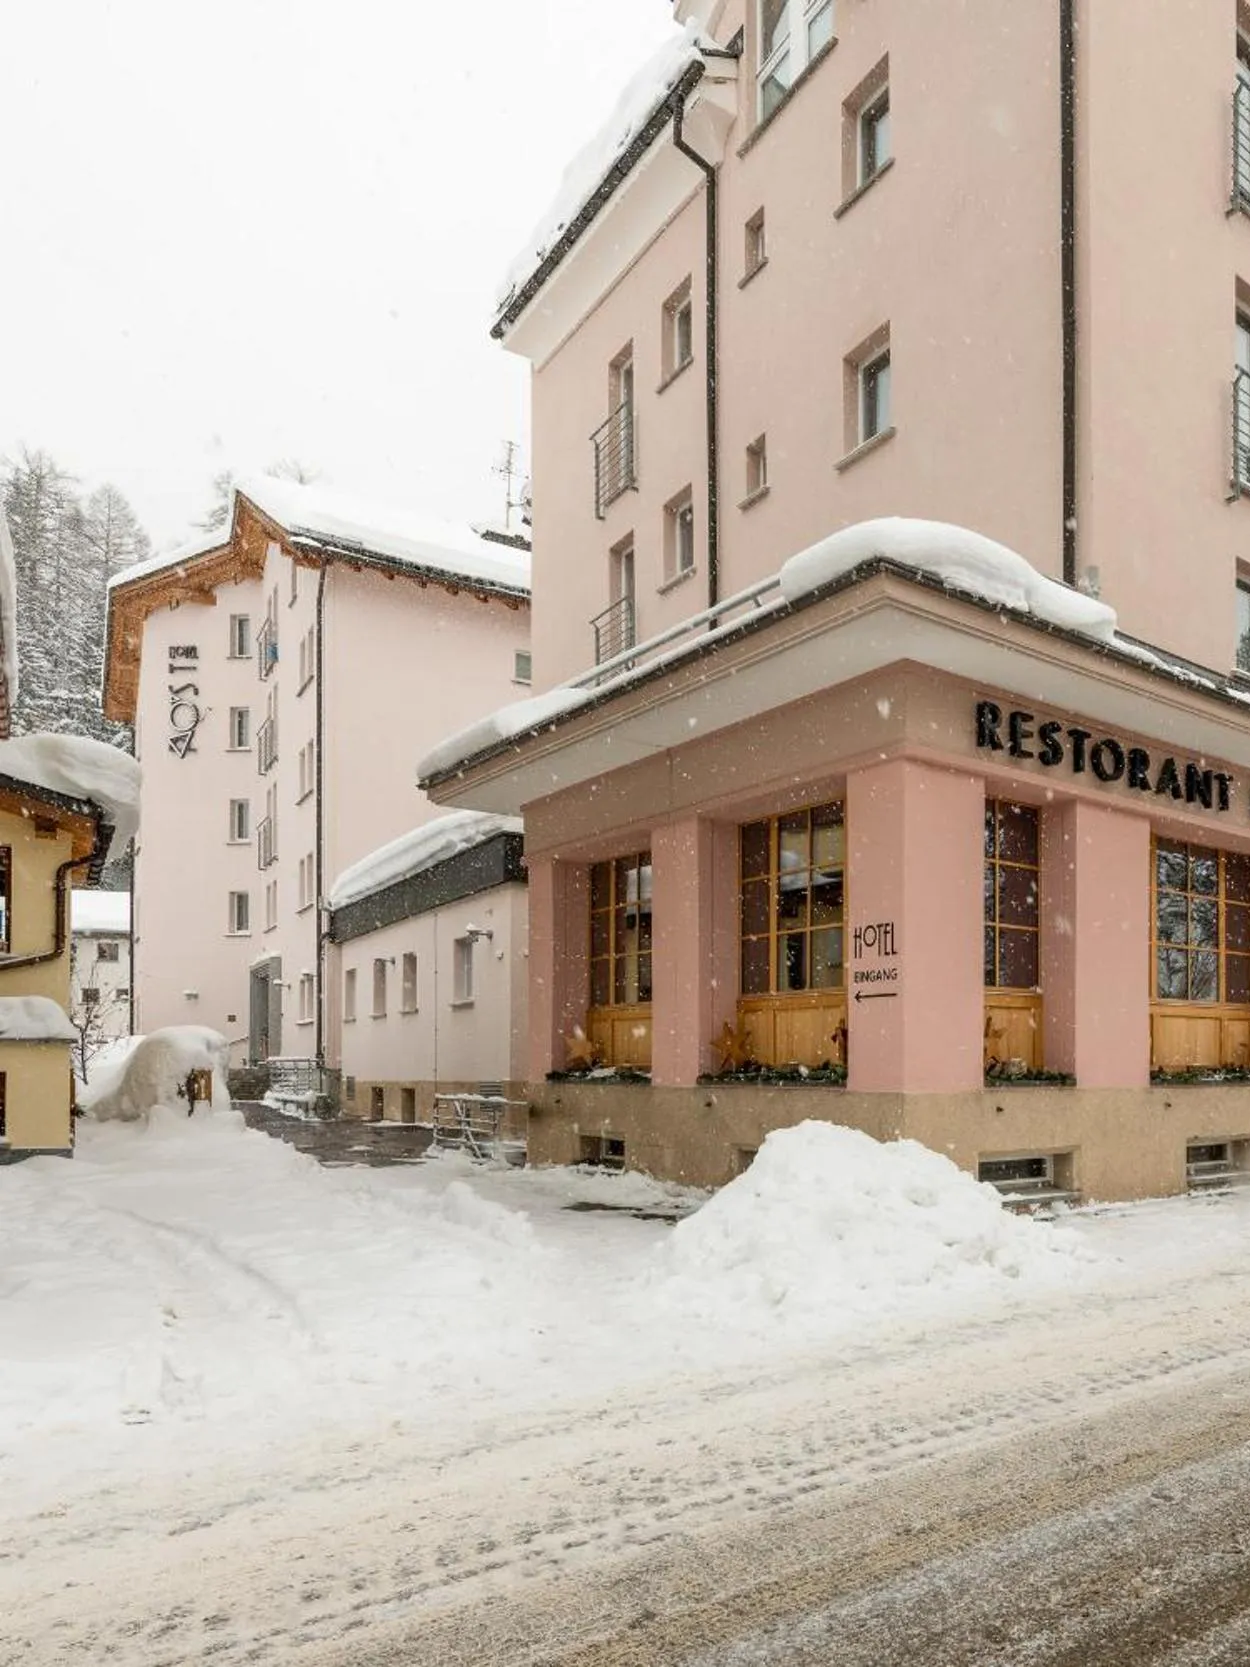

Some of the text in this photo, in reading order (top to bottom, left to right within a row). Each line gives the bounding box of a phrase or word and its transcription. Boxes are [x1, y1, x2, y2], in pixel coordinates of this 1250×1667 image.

[976, 700, 1233, 811] RESTORANT
[853, 922, 897, 959] HOTEL
[854, 968, 898, 983] EINGANG
